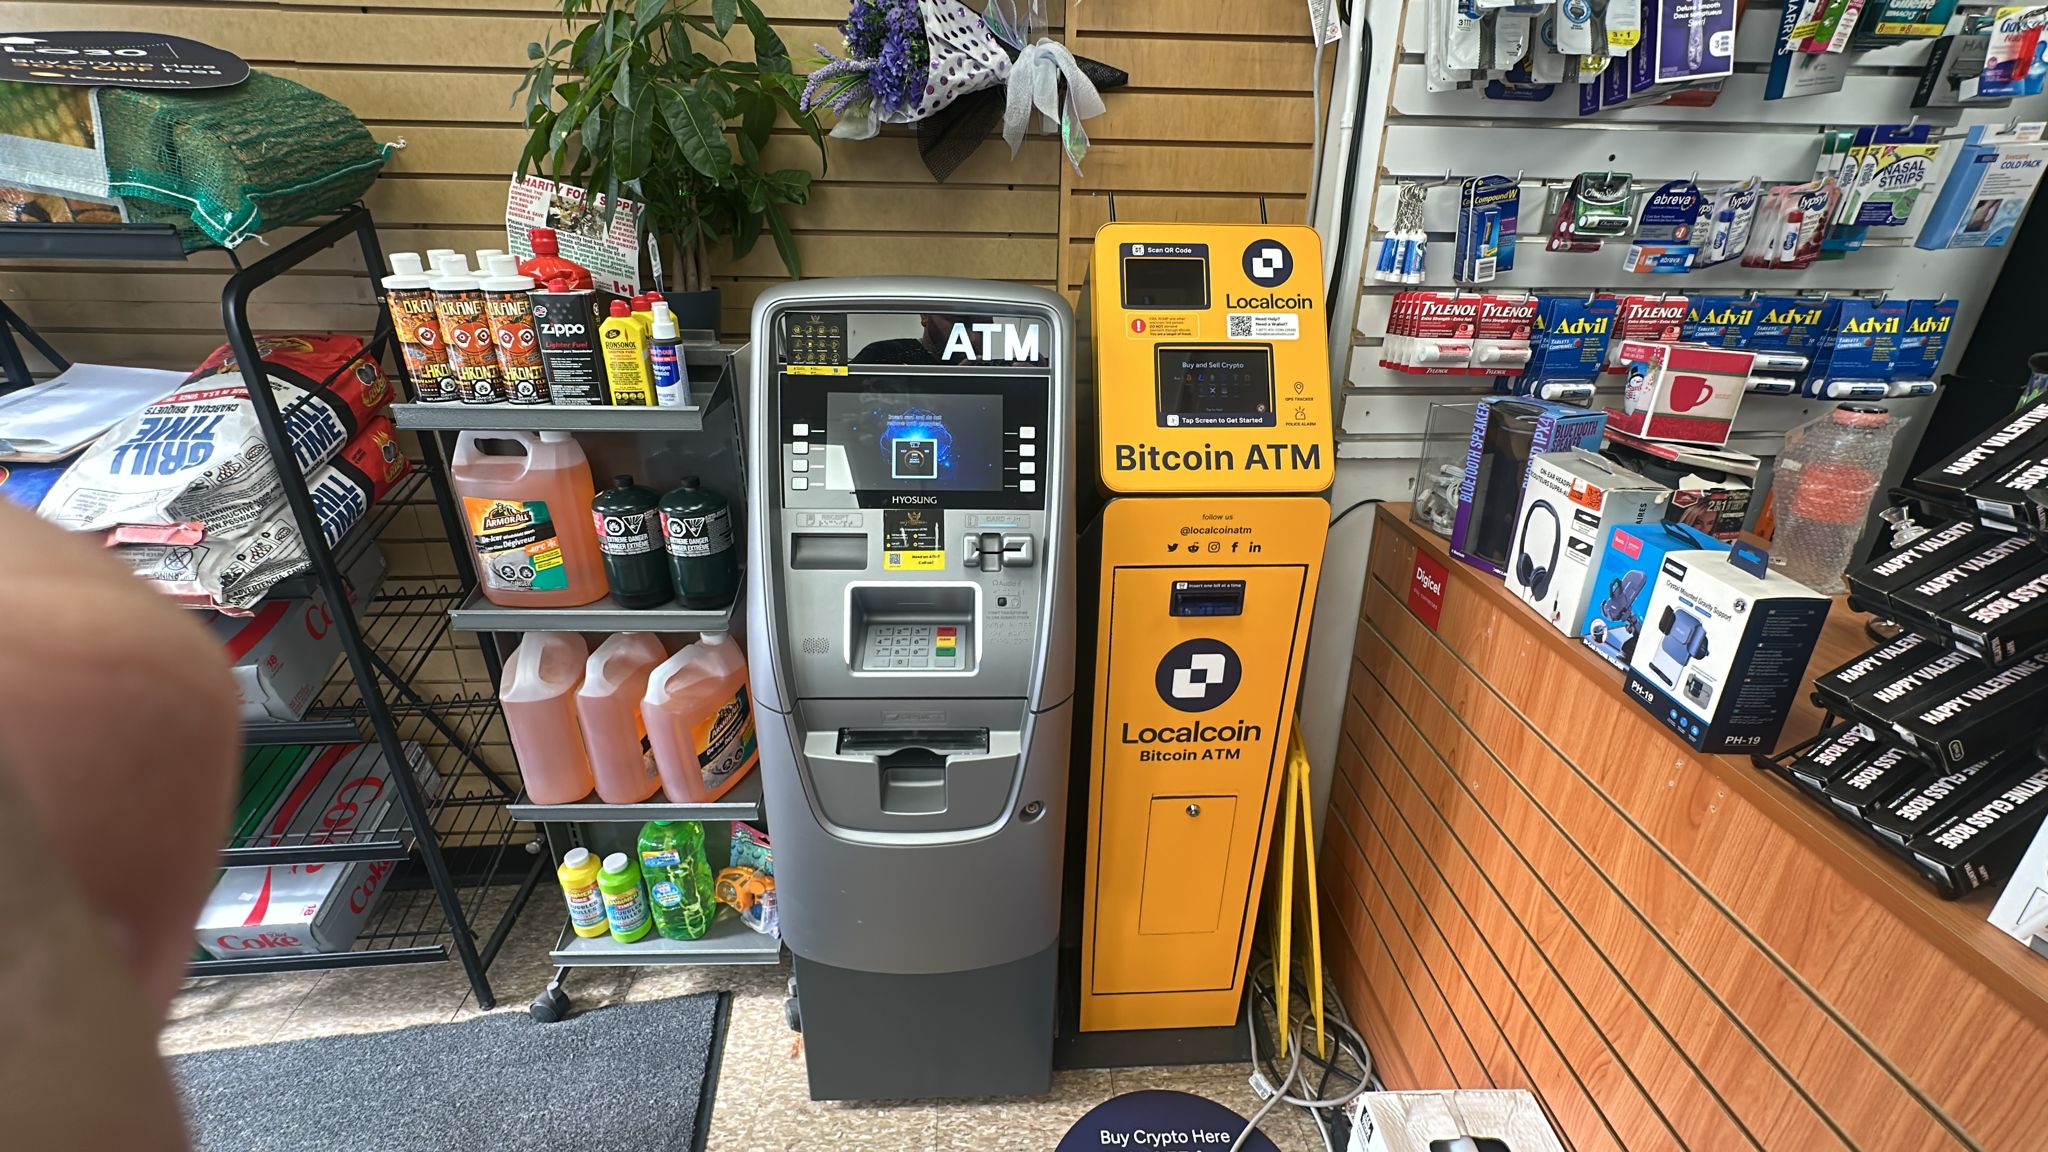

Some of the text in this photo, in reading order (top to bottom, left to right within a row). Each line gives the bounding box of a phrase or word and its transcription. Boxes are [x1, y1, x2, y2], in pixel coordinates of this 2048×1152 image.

[1673, 12, 1689, 20] Doux
[1714, 40, 1720, 49] 3
[11, 57, 60, 66] Buy
[67, 59, 154, 67] Crypto
[1883, 159, 1926, 176] NASAL
[2000, 159, 2042, 170] COLD PACK
[1878, 172, 1924, 188] STRIPS
[1474, 193, 1508, 205] Compound
[1653, 193, 1692, 206] abreva
[1800, 193, 1828, 209] lypsyl
[1164, 247, 1174, 255] QR
[1175, 247, 1192, 255] Code
[1660, 256, 1681, 264] abreva
[1225, 293, 1313, 310] Localcoin
[1421, 300, 1478, 317] TYLENOL
[1481, 302, 1536, 319] TYLENOL
[1629, 304, 1685, 320] TYLENOL
[1701, 308, 1754, 326] Advil
[1759, 308, 1823, 326] Advil
[540, 322, 585, 337] Zippo
[1553, 316, 1609, 334] Advil
[1840, 316, 1900, 334] Advil
[1905, 316, 1951, 333] Advil
[605, 341, 636, 349] RONSONOL
[941, 322, 1040, 362] ATM
[1181, 362, 1194, 370] Buy
[1221, 362, 1244, 370] Crypto
[144, 403, 240, 416] CHARCOAL BRIQUETS
[127, 414, 225, 443] TIME
[1181, 417, 1194, 425] Tap
[1239, 416, 1263, 424] Started
[1554, 420, 1599, 437] BLUETOOTH
[1534, 414, 1553, 446] IPX4
[292, 413, 343, 470] TIME
[1552, 436, 1582, 451] SPEAKER
[109, 441, 215, 476] GRILL
[1115, 443, 1321, 471] Bitcoin ATM
[1458, 401, 1491, 505] BLUETOOTH SPEAKER
[1942, 441, 1996, 477] HAPPY
[1540, 467, 1556, 481] ON-EAR
[891, 496, 938, 505] HYOSUNG
[323, 491, 366, 548] TIME
[1202, 513, 1223, 521] follow
[606, 533, 649, 543] EXTREME DANGER
[1180, 525, 1252, 537] @localcoinatm
[503, 535, 536, 549] Dégivreur
[608, 542, 626, 551] DANGER
[670, 537, 709, 545] EXTREME DANGER
[1872, 548, 1924, 577] HAPPY
[1415, 566, 1442, 596] Digicel
[1914, 566, 1969, 597] HAPPY
[1665, 579, 1732, 622] Crystal Mounted Gravity Support
[1968, 596, 2020, 624] ROSE
[1836, 632, 1928, 684] HAPPY VALENT
[1873, 650, 1971, 704] HAPPY VALENT
[1630, 680, 1654, 702] PH-19
[1918, 658, 2045, 726] HAPPY VALENTINE
[1121, 719, 1262, 745] Localcoin
[1724, 735, 1761, 745] PH-19
[1139, 748, 1241, 762] Bitcoin ATM
[1813, 745, 1849, 767] ROSE
[1846, 764, 1885, 790] ROSE
[1895, 773, 1968, 822] GLASS ROSE
[1934, 798, 2015, 850] GLASS ROSE
[216, 932, 303, 951] Coke
[1100, 1128, 1231, 1148] Buy Crypto Here
